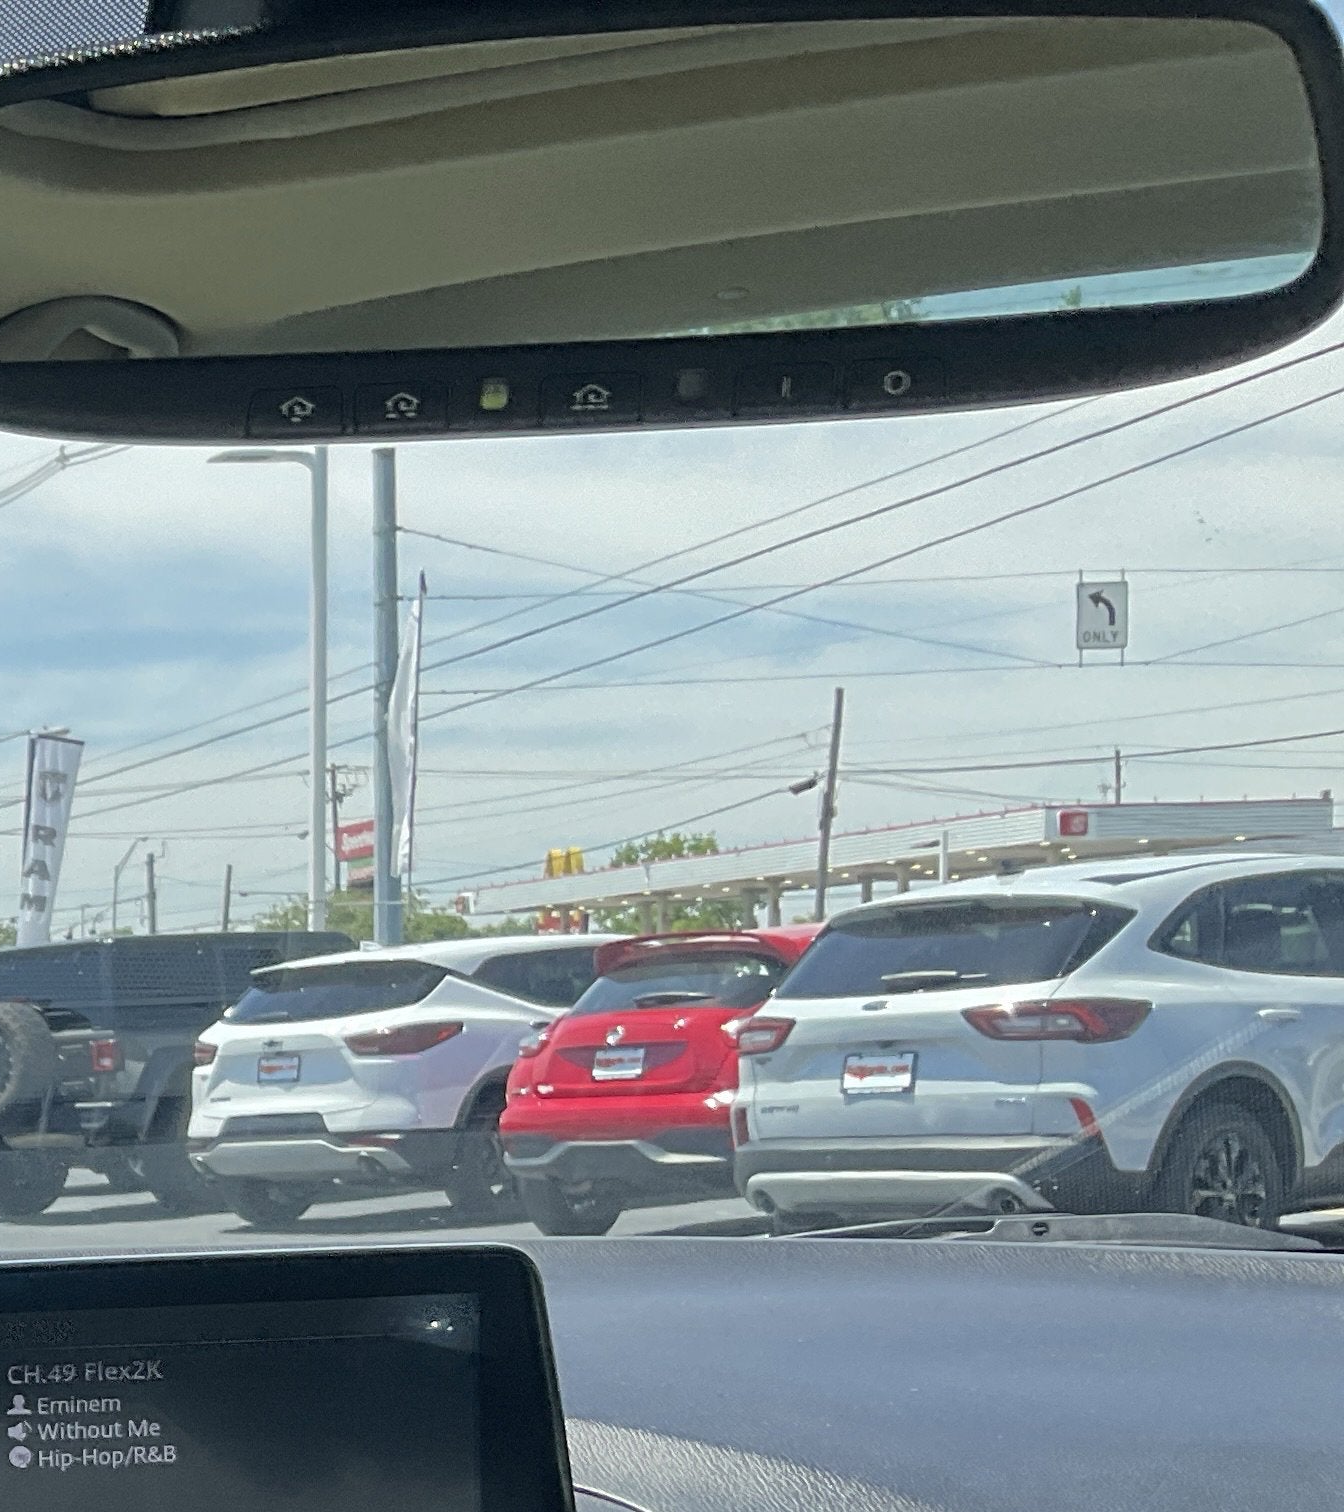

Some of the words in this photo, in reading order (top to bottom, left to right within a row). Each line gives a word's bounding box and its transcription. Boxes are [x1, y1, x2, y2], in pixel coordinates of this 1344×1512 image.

[1082, 630, 1119, 644] ONLY
[7, 1363, 78, 1385] CH.49
[84, 1359, 164, 1382] Flex2K
[37, 1396, 122, 1415] Eminem
[37, 1421, 123, 1440] Without
[128, 1419, 162, 1438] Me
[38, 1445, 177, 1472] Hip-Hop/R&B
